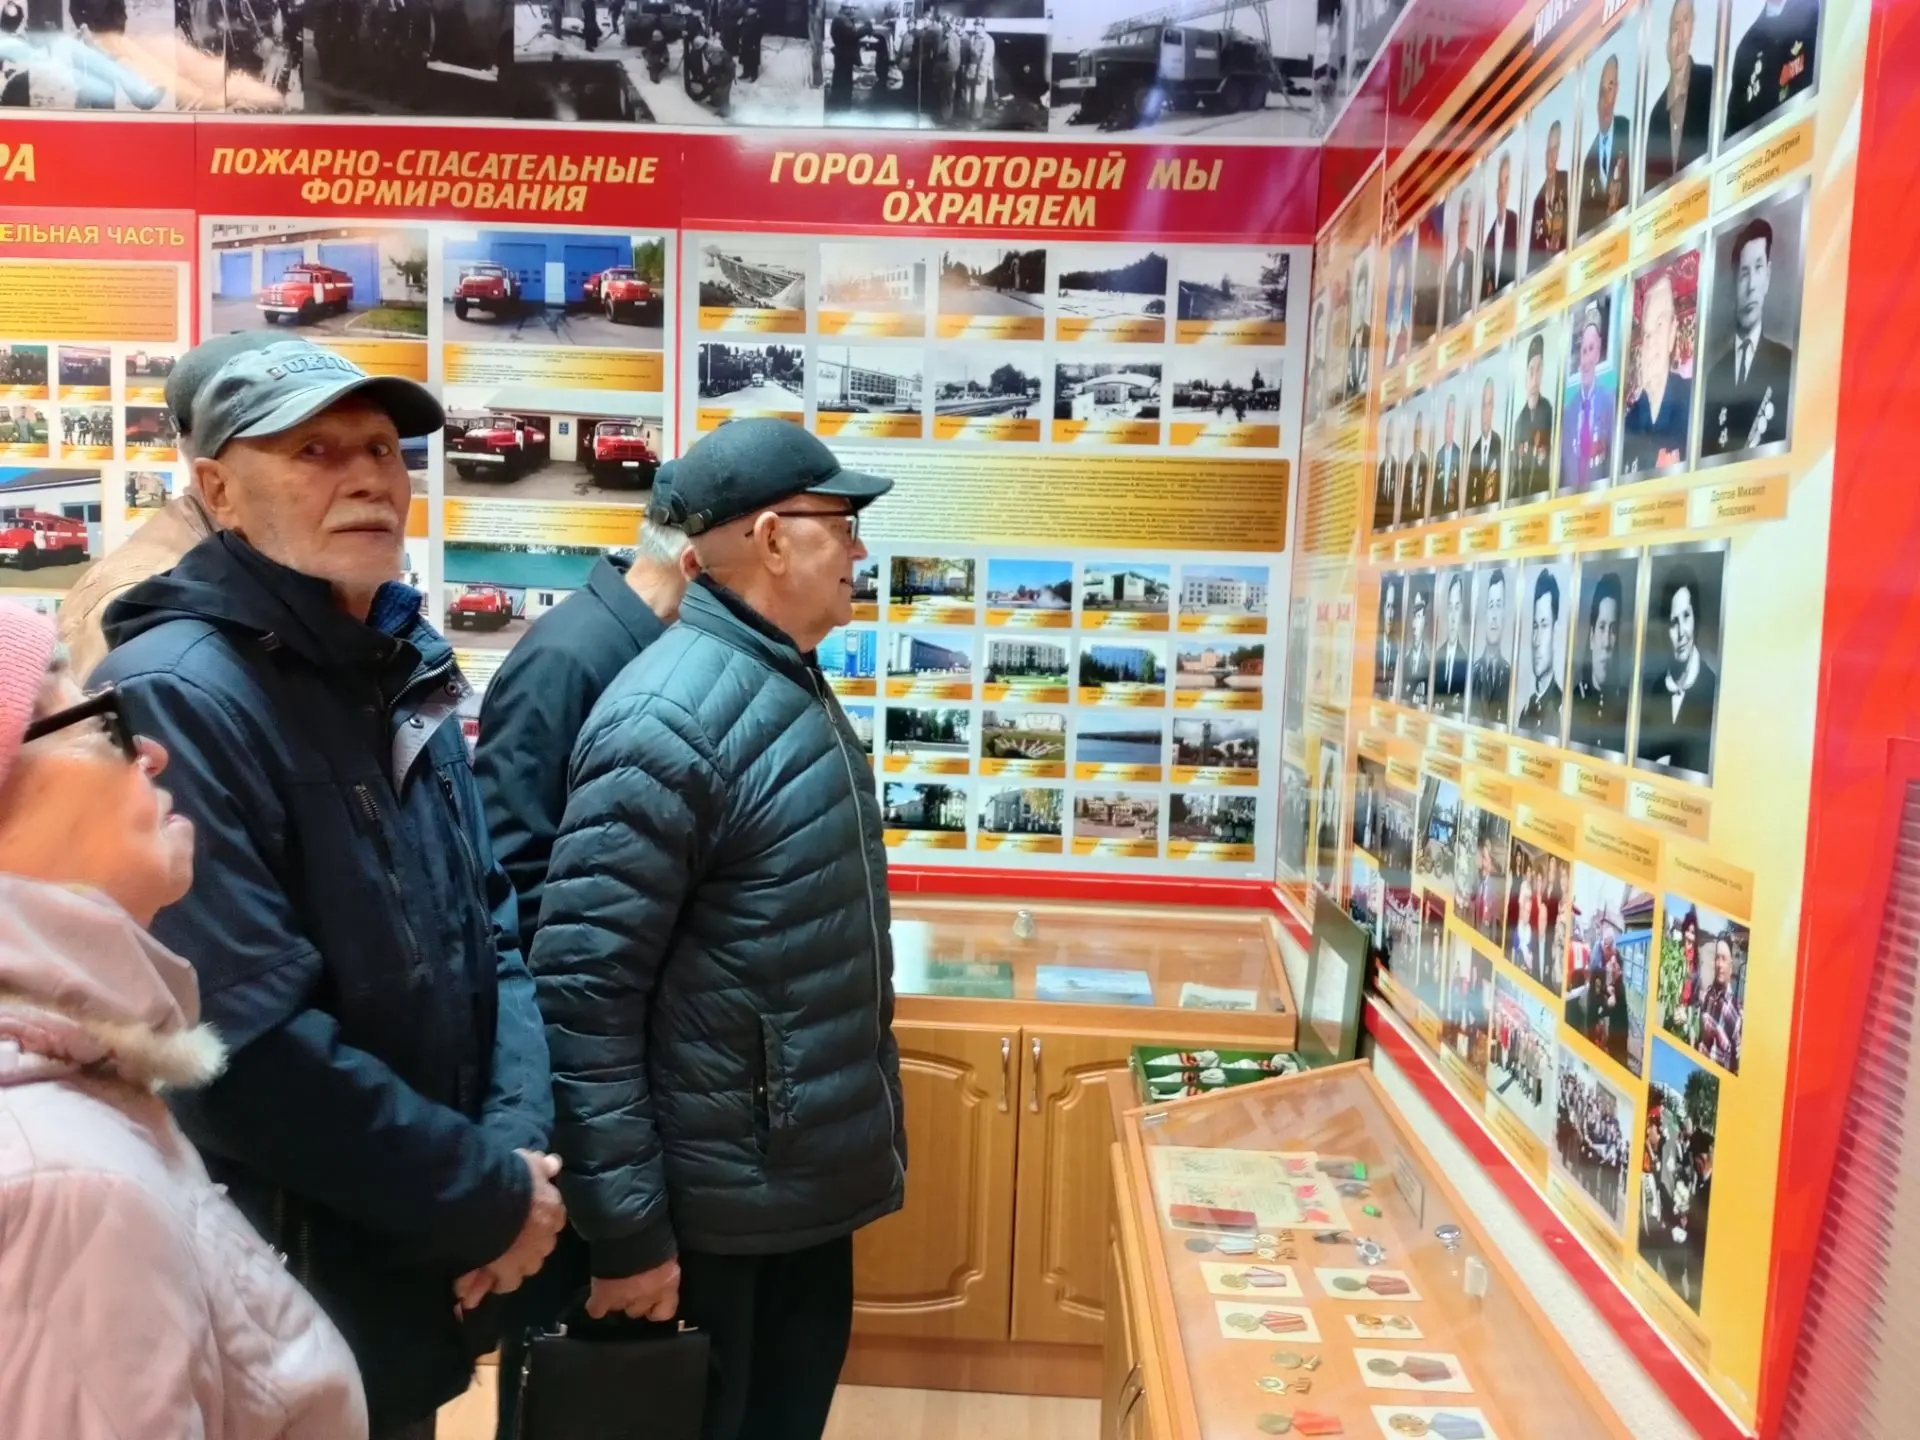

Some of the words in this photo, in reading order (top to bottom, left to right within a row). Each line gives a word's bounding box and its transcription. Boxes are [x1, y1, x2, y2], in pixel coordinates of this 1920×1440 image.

[210, 147, 659, 184] ПОЖАРНО-СПАСАТЕЛЬНЫЕ
[928, 151, 1126, 190] КОТОРЫЙ
[1147, 158, 1222, 191] МЫ
[301, 178, 588, 212] ФОРМИРОВАНИЯ
[882, 191, 1096, 227] ОХРАНЯЕМ
[107, 226, 185, 246] ЧАСТЬ
